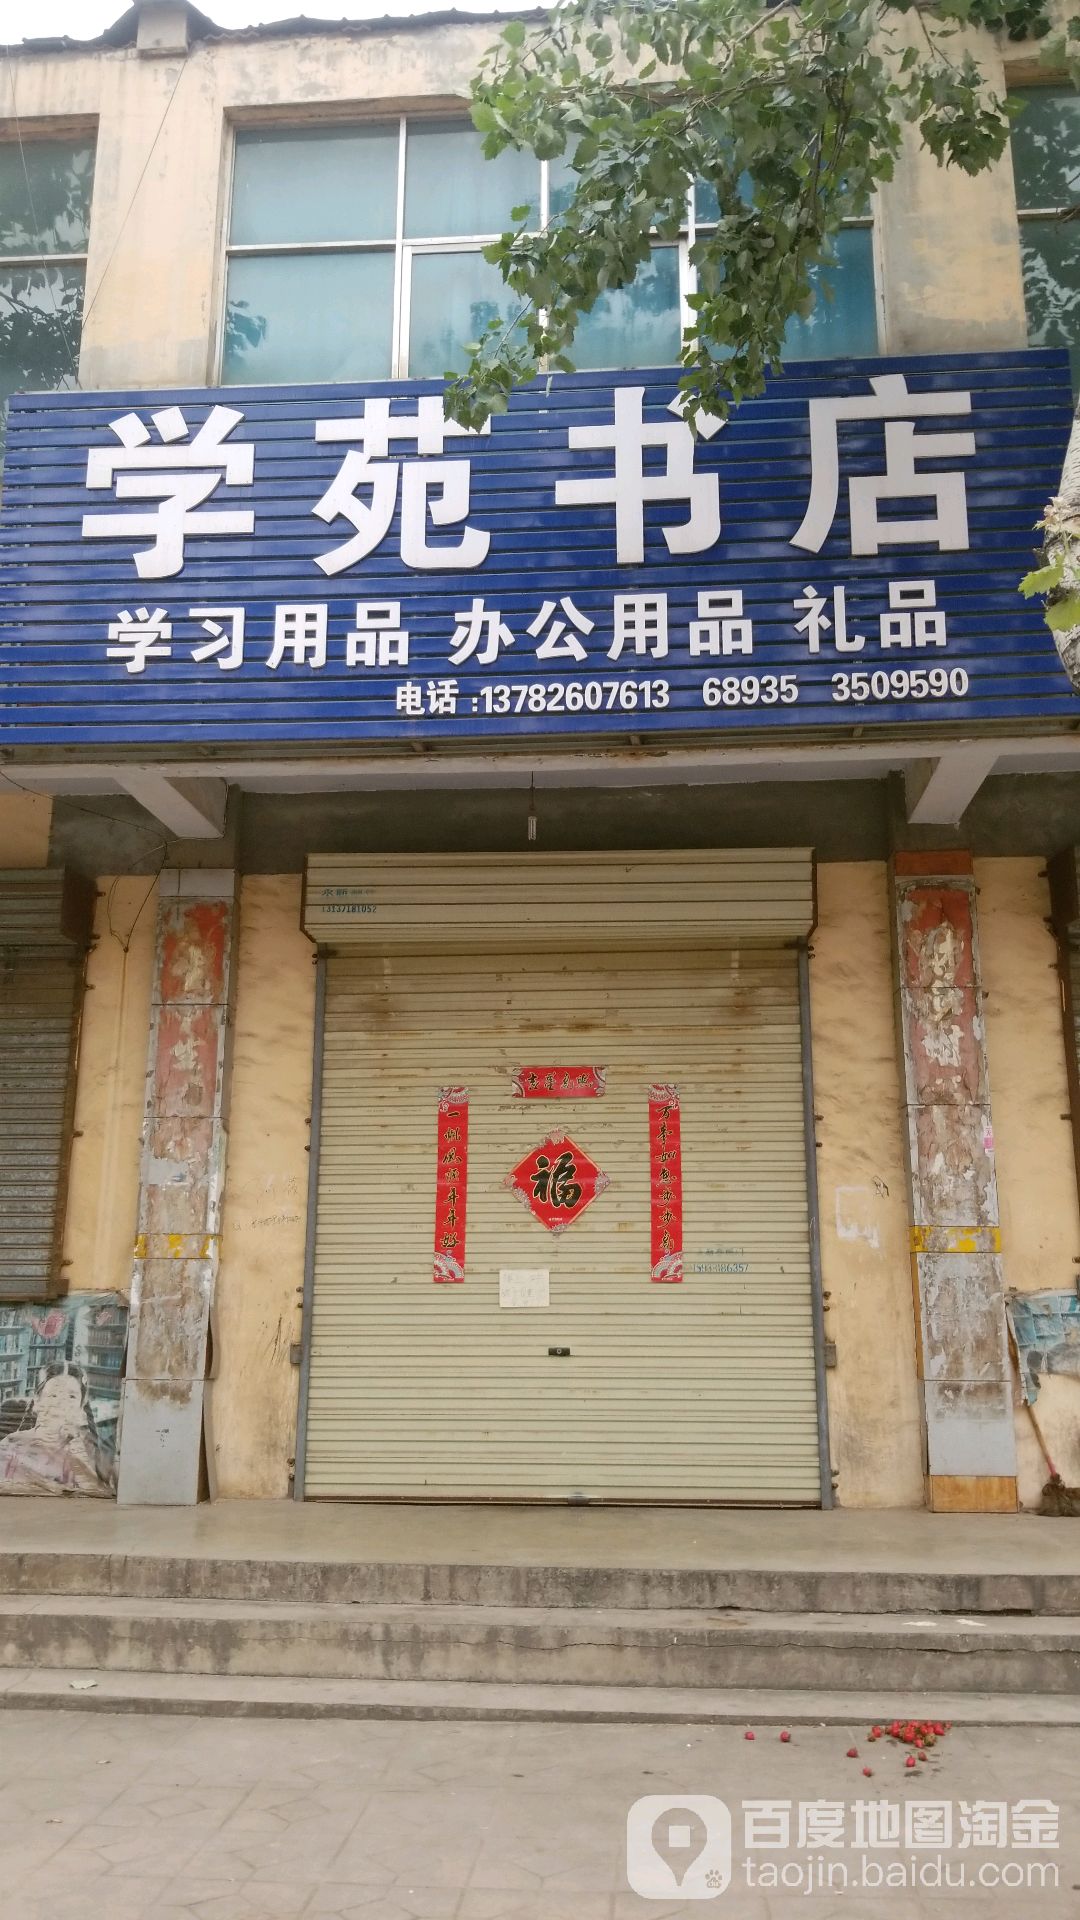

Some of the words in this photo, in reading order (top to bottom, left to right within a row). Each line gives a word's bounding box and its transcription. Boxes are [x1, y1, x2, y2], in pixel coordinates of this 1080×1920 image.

[82, 374, 976, 579] 学苑书店
[106, 600, 409, 674] 学习用品
[447, 592, 753, 666] 办公用品
[793, 579, 947, 654] 礼品
[701, 674, 800, 707] 68935
[831, 667, 971, 702] 3509590
[529, 1151, 583, 1209] 福
